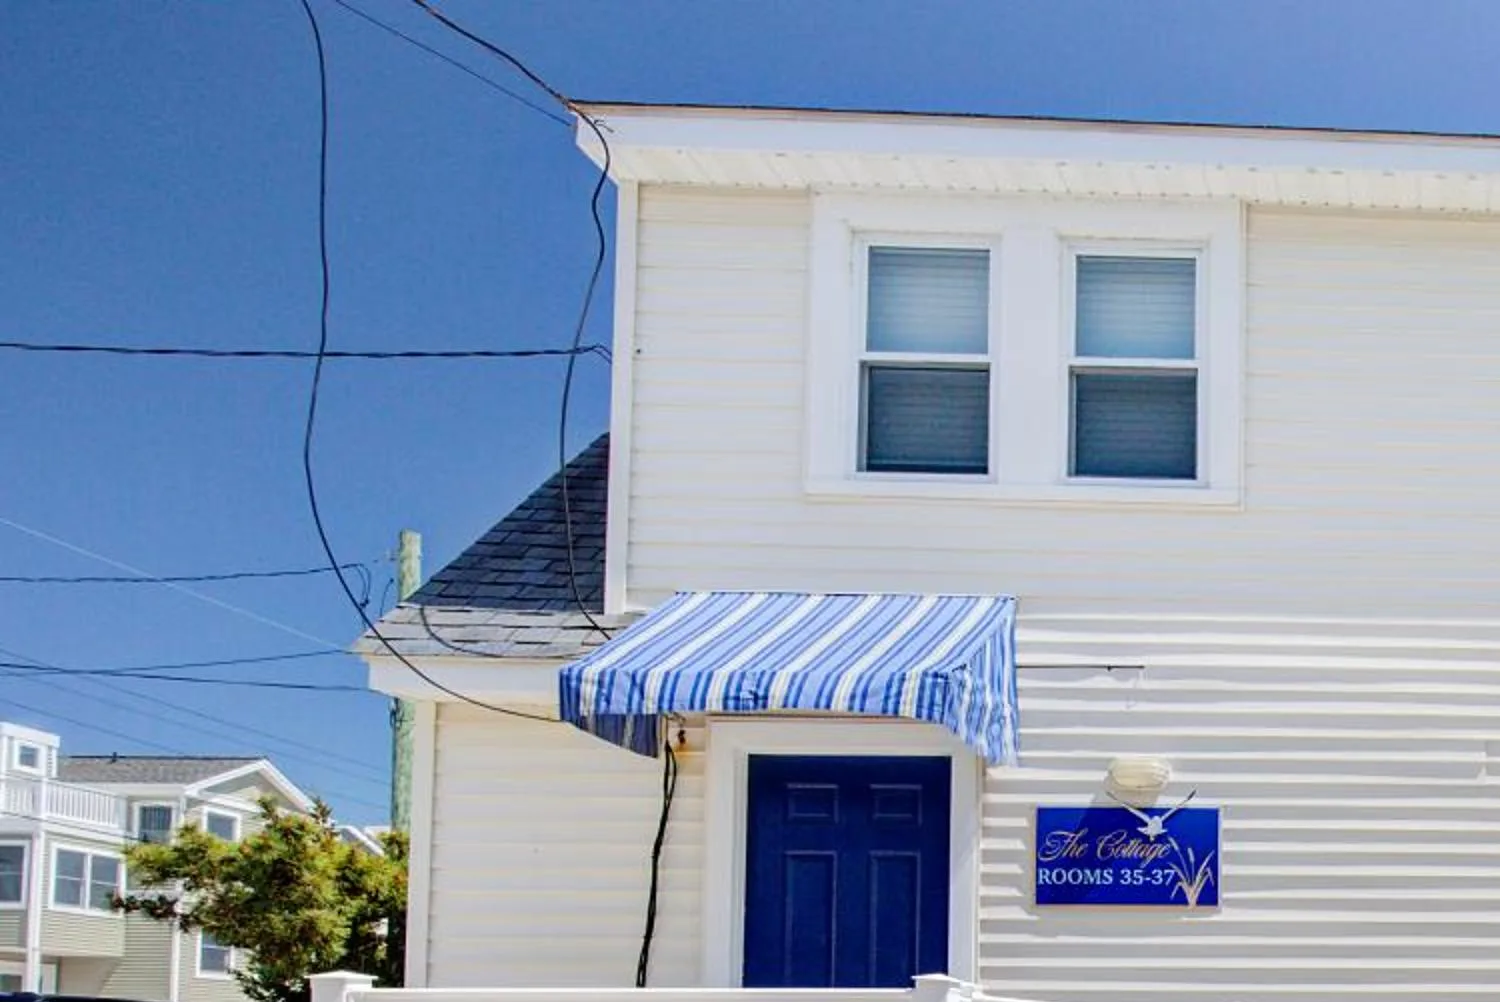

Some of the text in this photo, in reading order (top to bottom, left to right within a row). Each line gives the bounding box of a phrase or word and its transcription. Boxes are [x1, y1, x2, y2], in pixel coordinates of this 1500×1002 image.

[1038, 828, 1171, 868] The Cottage
[1038, 868, 1175, 886] ROOMS 35-37
